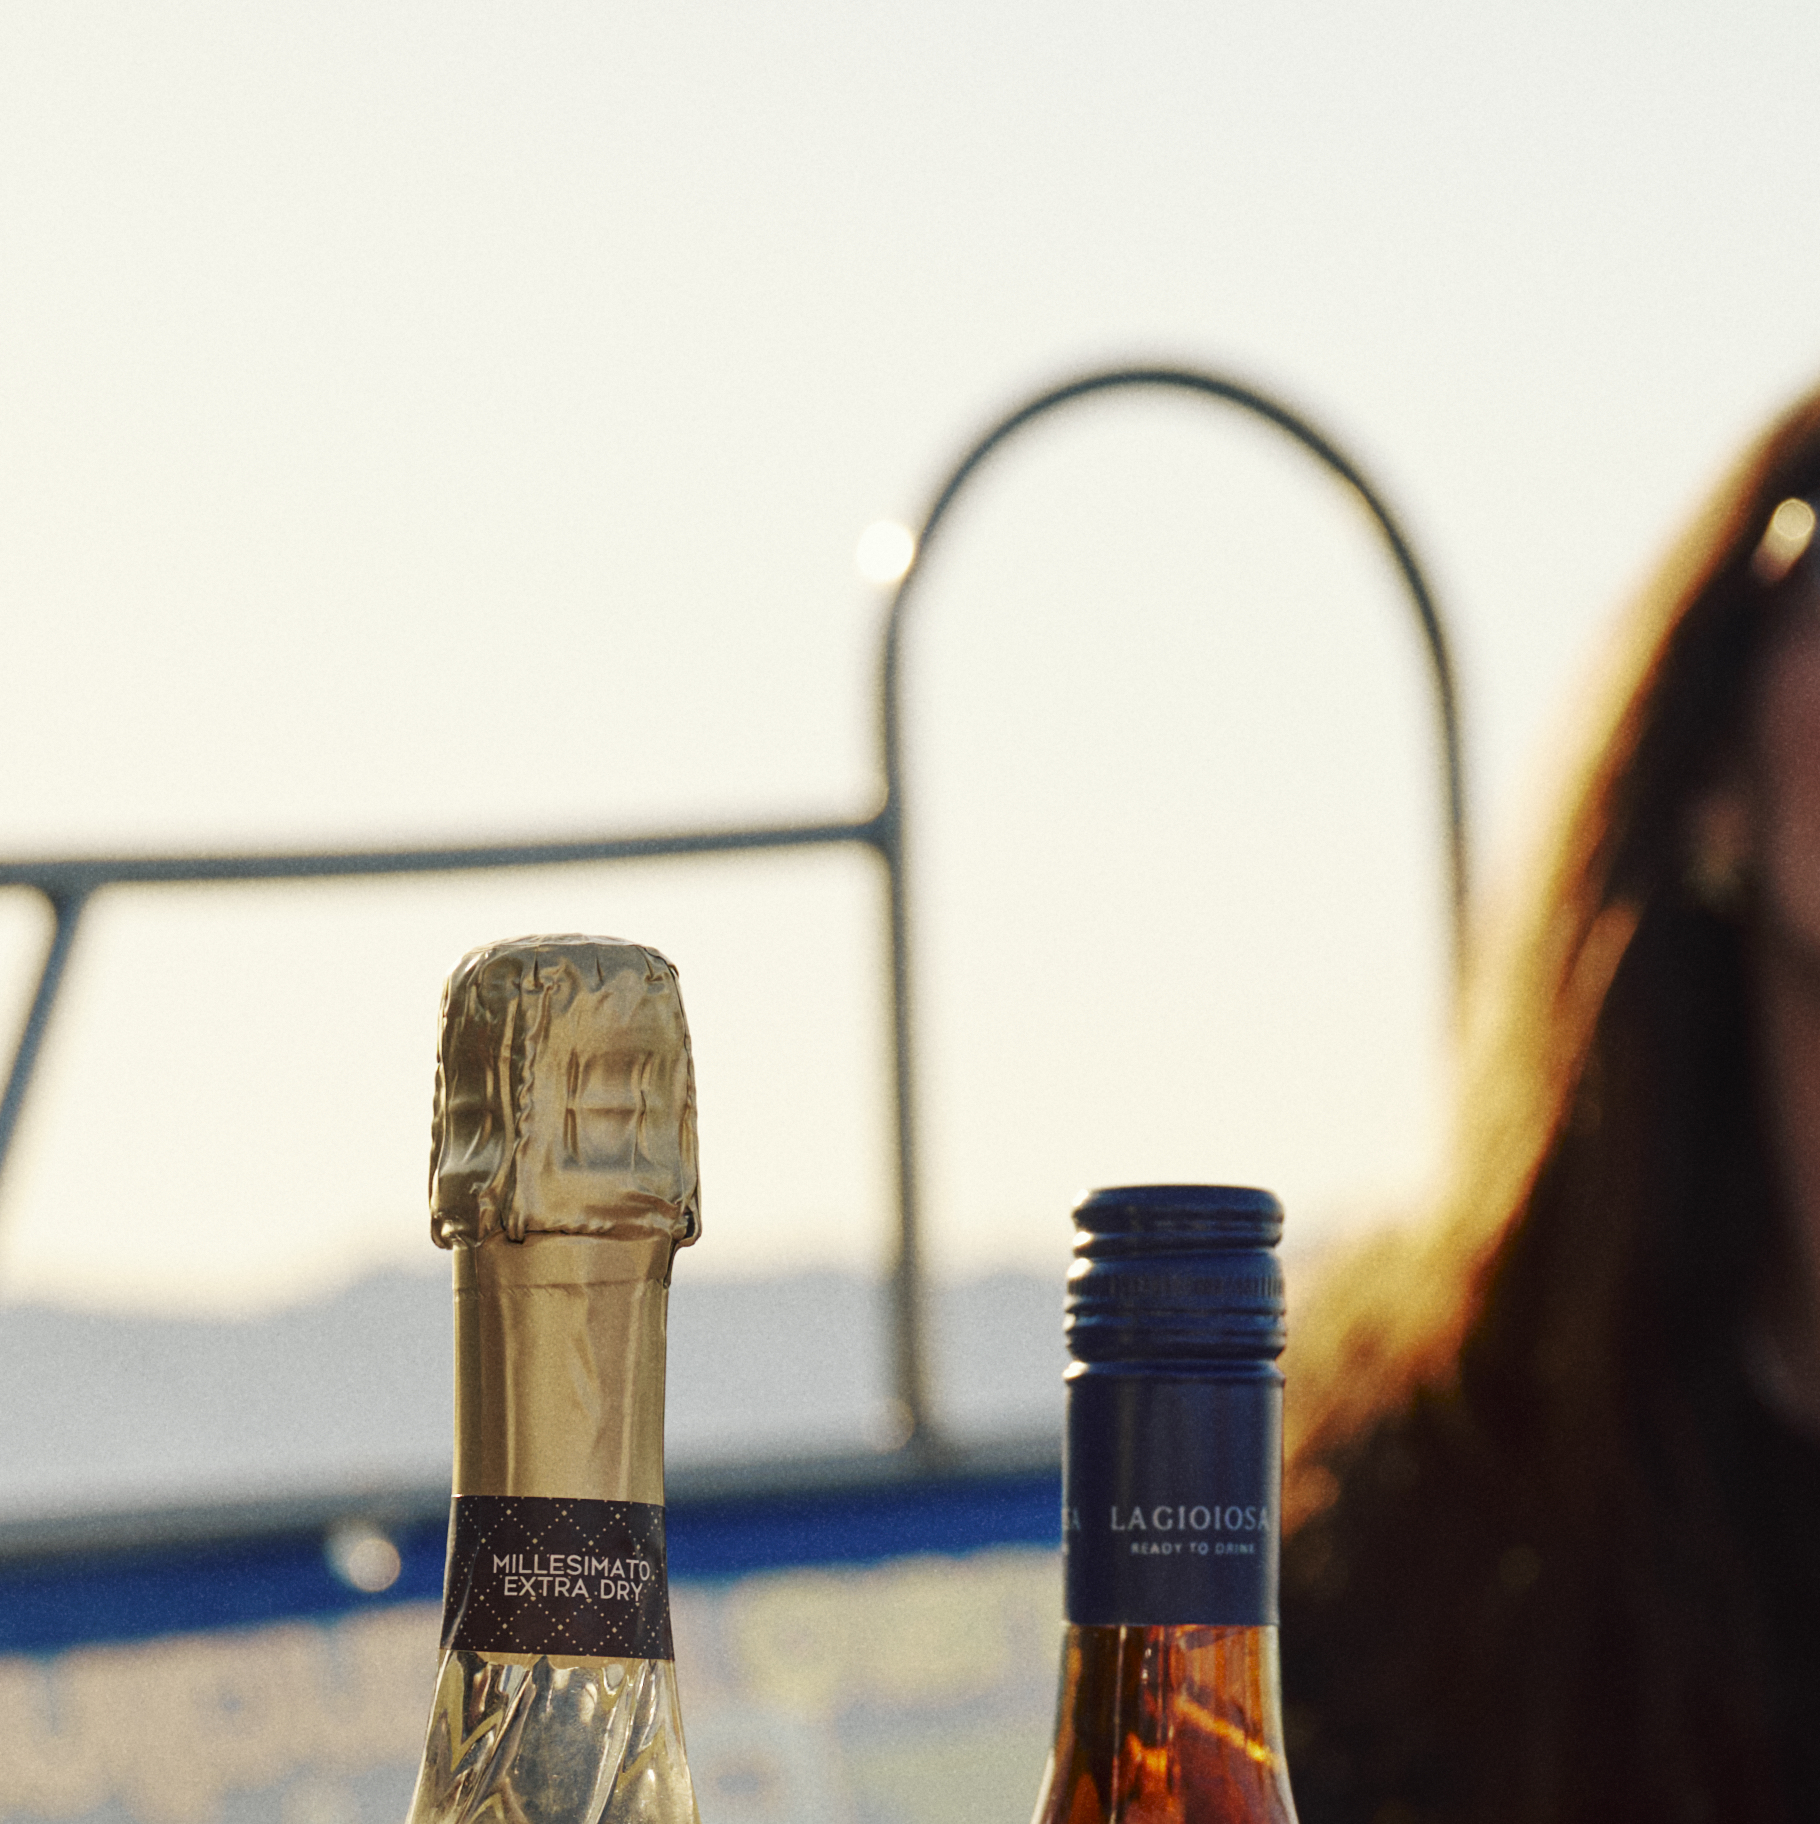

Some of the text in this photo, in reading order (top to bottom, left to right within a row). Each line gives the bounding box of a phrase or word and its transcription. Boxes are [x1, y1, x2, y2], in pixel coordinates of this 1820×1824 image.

[1130, 1542, 1181, 1556] READY
[1189, 1542, 1210, 1556] TO
[492, 1553, 651, 1581] MILLESIMATO
[503, 1576, 643, 1602] EXTRA DRY
